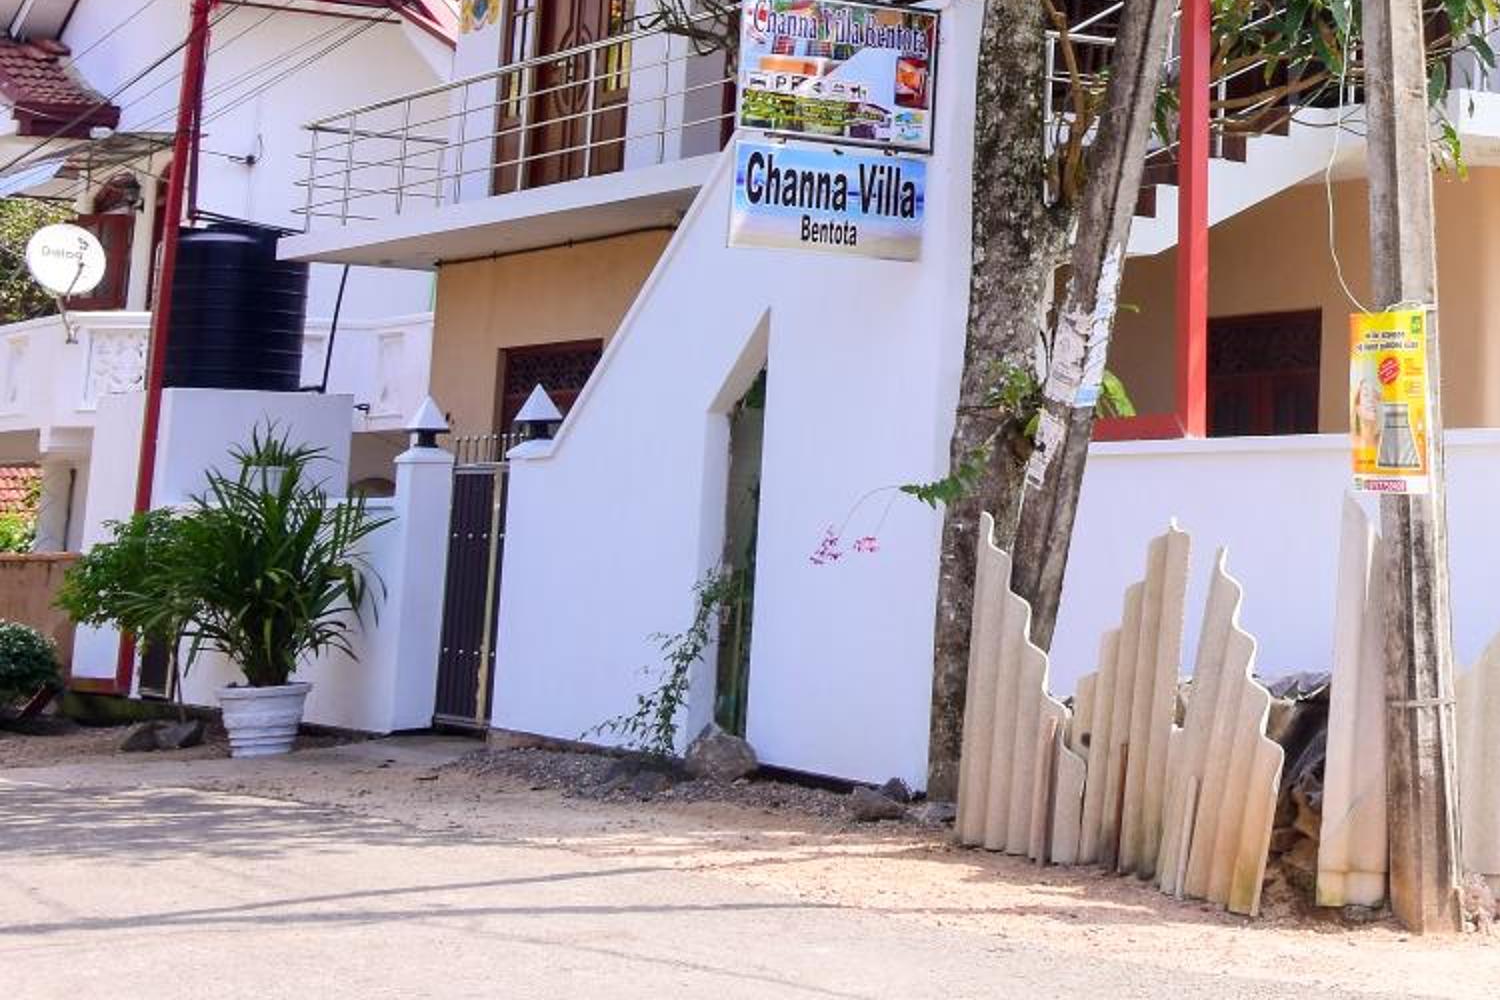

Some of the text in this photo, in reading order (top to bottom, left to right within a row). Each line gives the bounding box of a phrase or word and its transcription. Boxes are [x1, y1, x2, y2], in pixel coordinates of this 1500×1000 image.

[821, 6, 863, 45] Villa
[865, 13, 928, 58] Bentota
[746, 151, 916, 219] Channa Villa
[800, 214, 857, 246] Bentota
